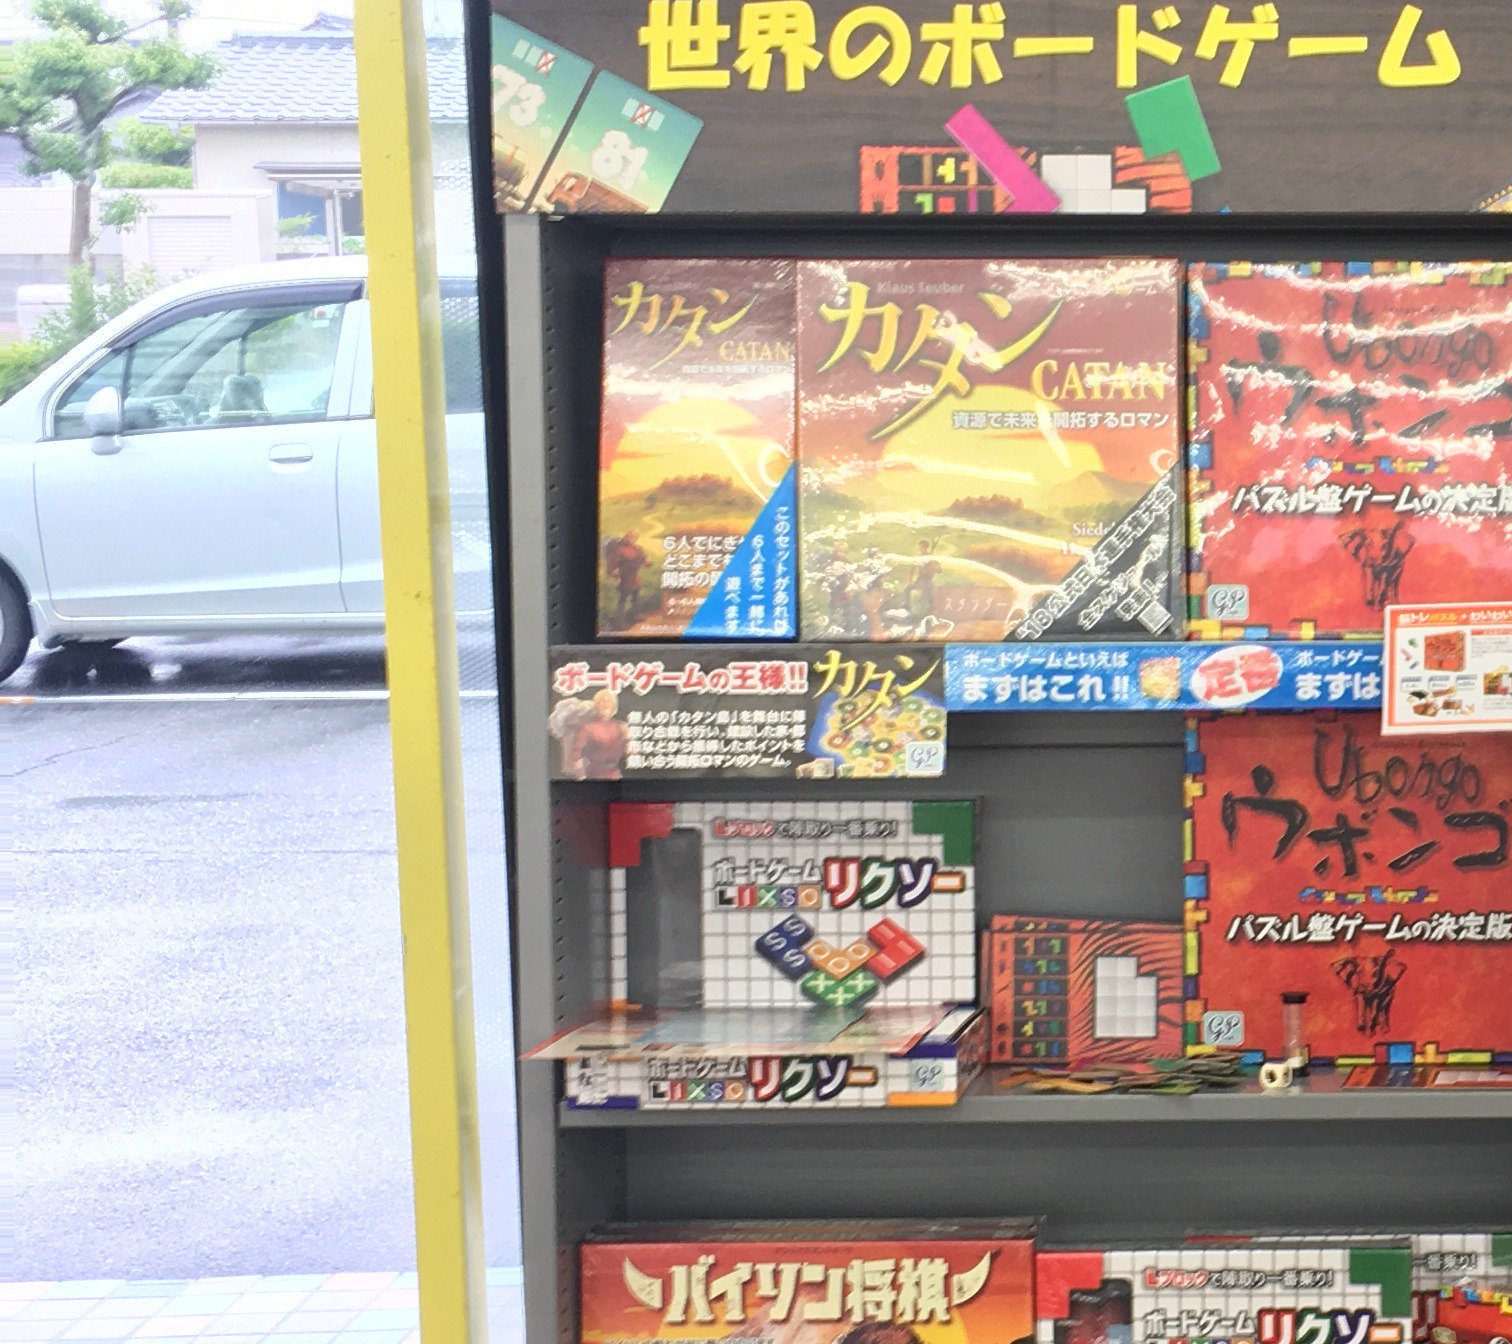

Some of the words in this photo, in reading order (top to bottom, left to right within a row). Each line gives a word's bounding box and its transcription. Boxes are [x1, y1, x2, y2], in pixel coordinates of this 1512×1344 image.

[611, 280, 761, 374] カタン
[718, 341, 792, 362] CATAN
[818, 279, 1066, 441] カタン
[1030, 358, 1168, 402] CATAN
[553, 660, 809, 695] ボードゲームの王様!!
[962, 651, 1129, 668] ボードゲームといえば
[812, 649, 941, 732] カタン
[962, 673, 1130, 703] まずはこれ!!
[1312, 723, 1484, 809] Ubongo
[714, 857, 822, 887] ボードゲーム
[824, 856, 965, 909] リクソー
[717, 886, 822, 910] LIXSO
[650, 1080, 747, 1102] LIXSO
[748, 1057, 878, 1102] リクソー
[663, 1255, 952, 1324] バイソン将棋
[1143, 1308, 1257, 1341] ボードゲーム
